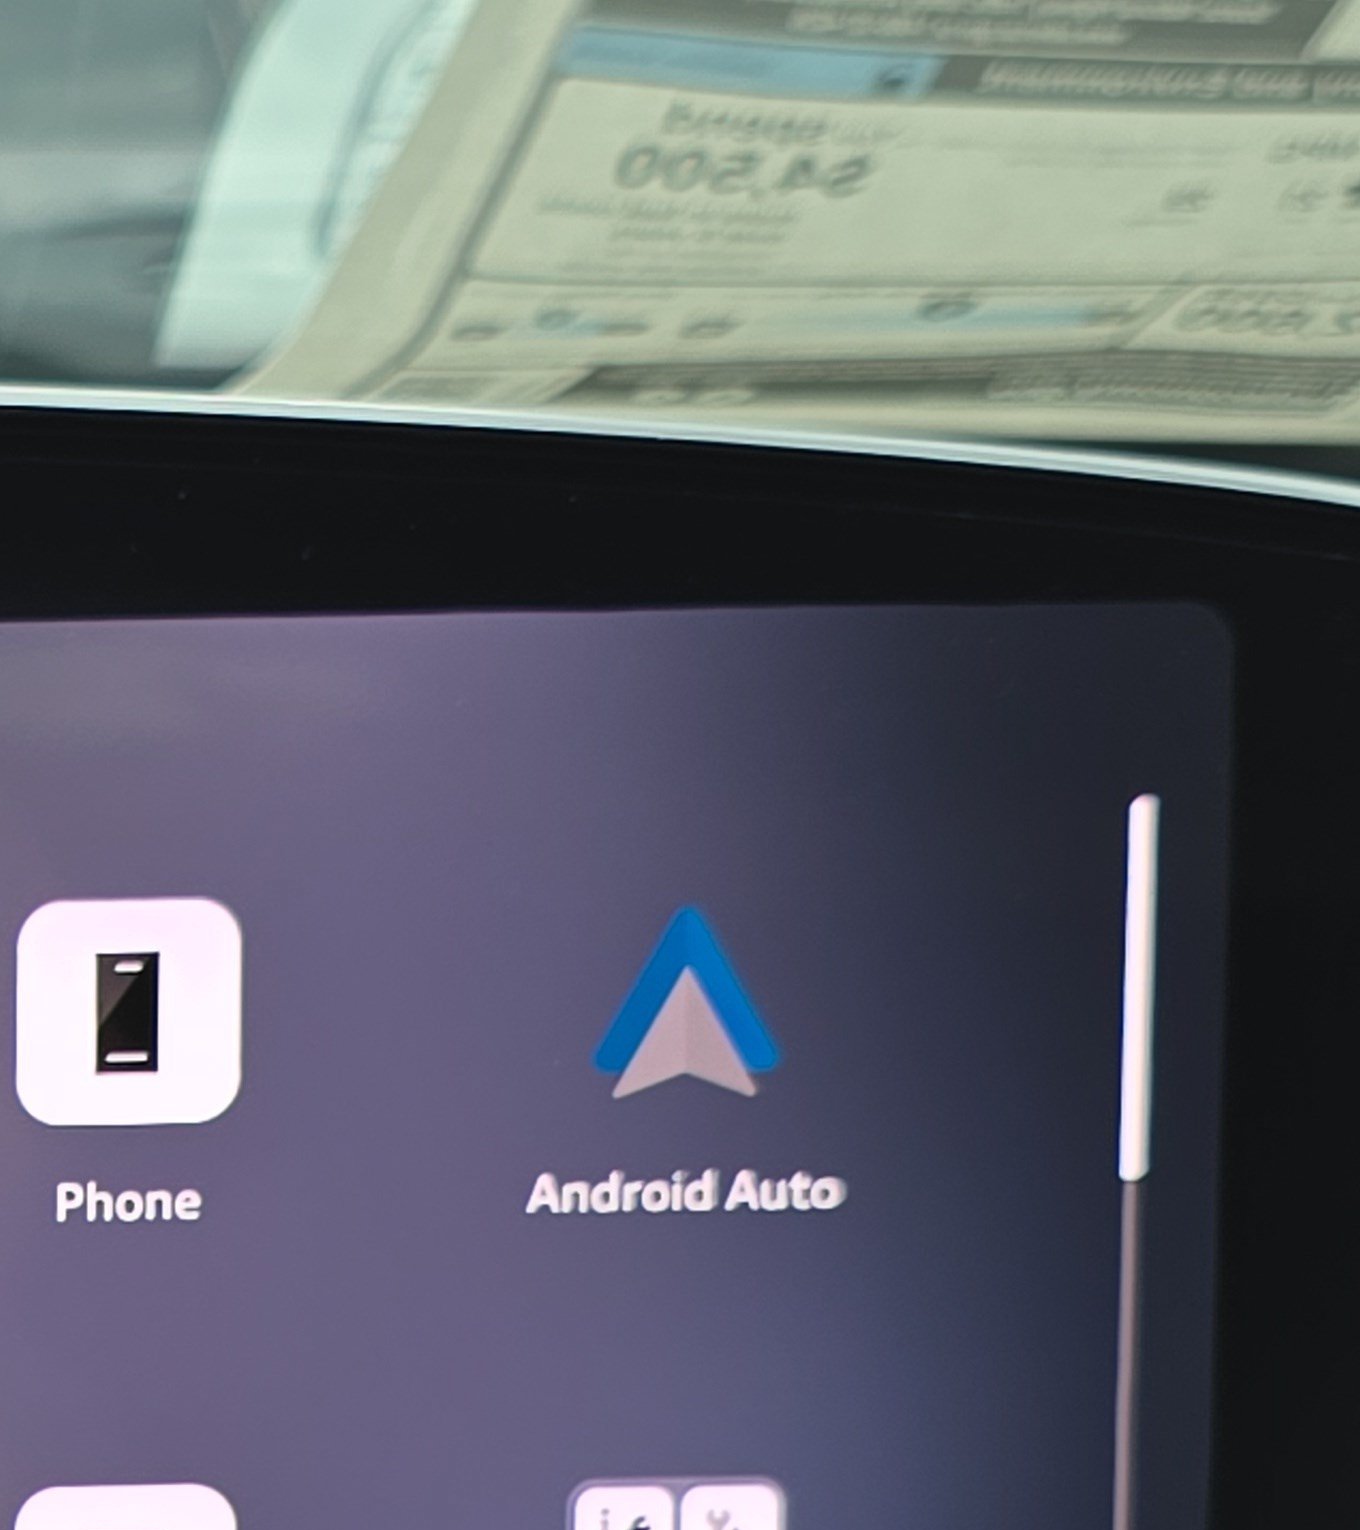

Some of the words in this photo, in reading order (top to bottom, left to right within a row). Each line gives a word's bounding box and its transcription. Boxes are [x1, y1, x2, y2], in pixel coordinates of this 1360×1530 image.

[55, 1180, 203, 1224] Phone
[525, 1168, 721, 1214] Android
[723, 1168, 847, 1212] Auto
